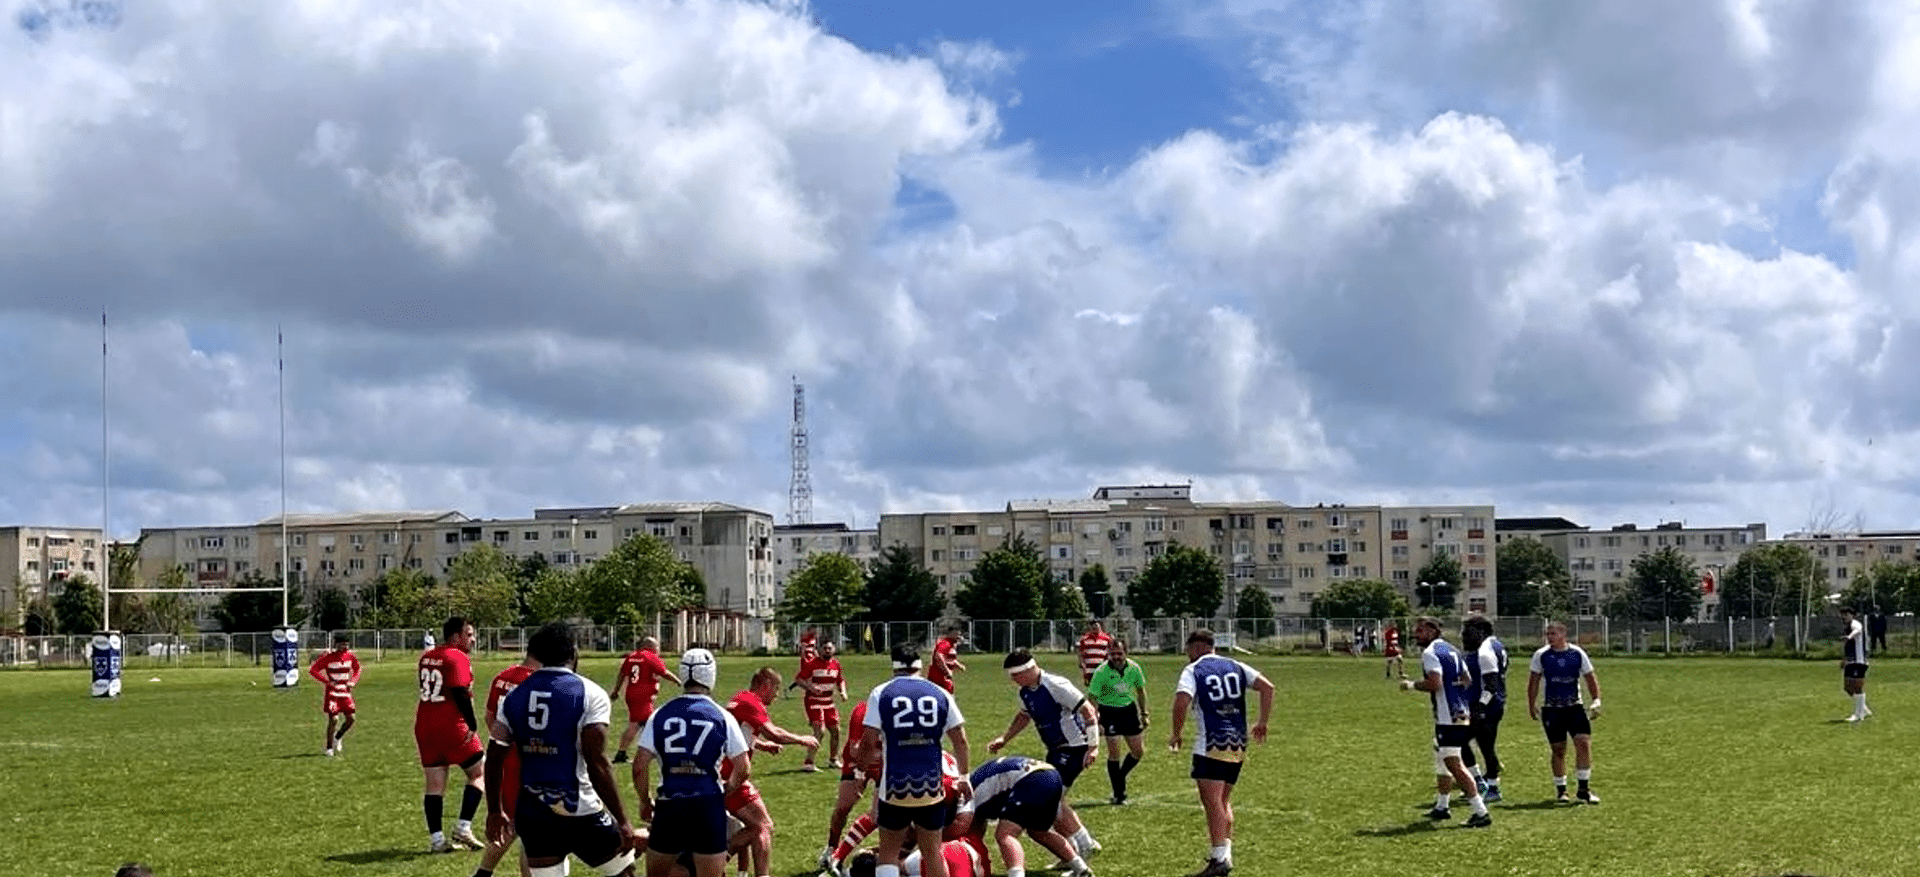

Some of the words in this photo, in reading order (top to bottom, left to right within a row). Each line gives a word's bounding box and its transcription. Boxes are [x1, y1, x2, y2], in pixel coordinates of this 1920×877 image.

[420, 668, 445, 702] 32
[631, 664, 640, 684] 3
[1205, 672, 1242, 701] 30
[528, 690, 552, 730] 5
[892, 695, 938, 728] 29
[663, 717, 714, 755] 27
